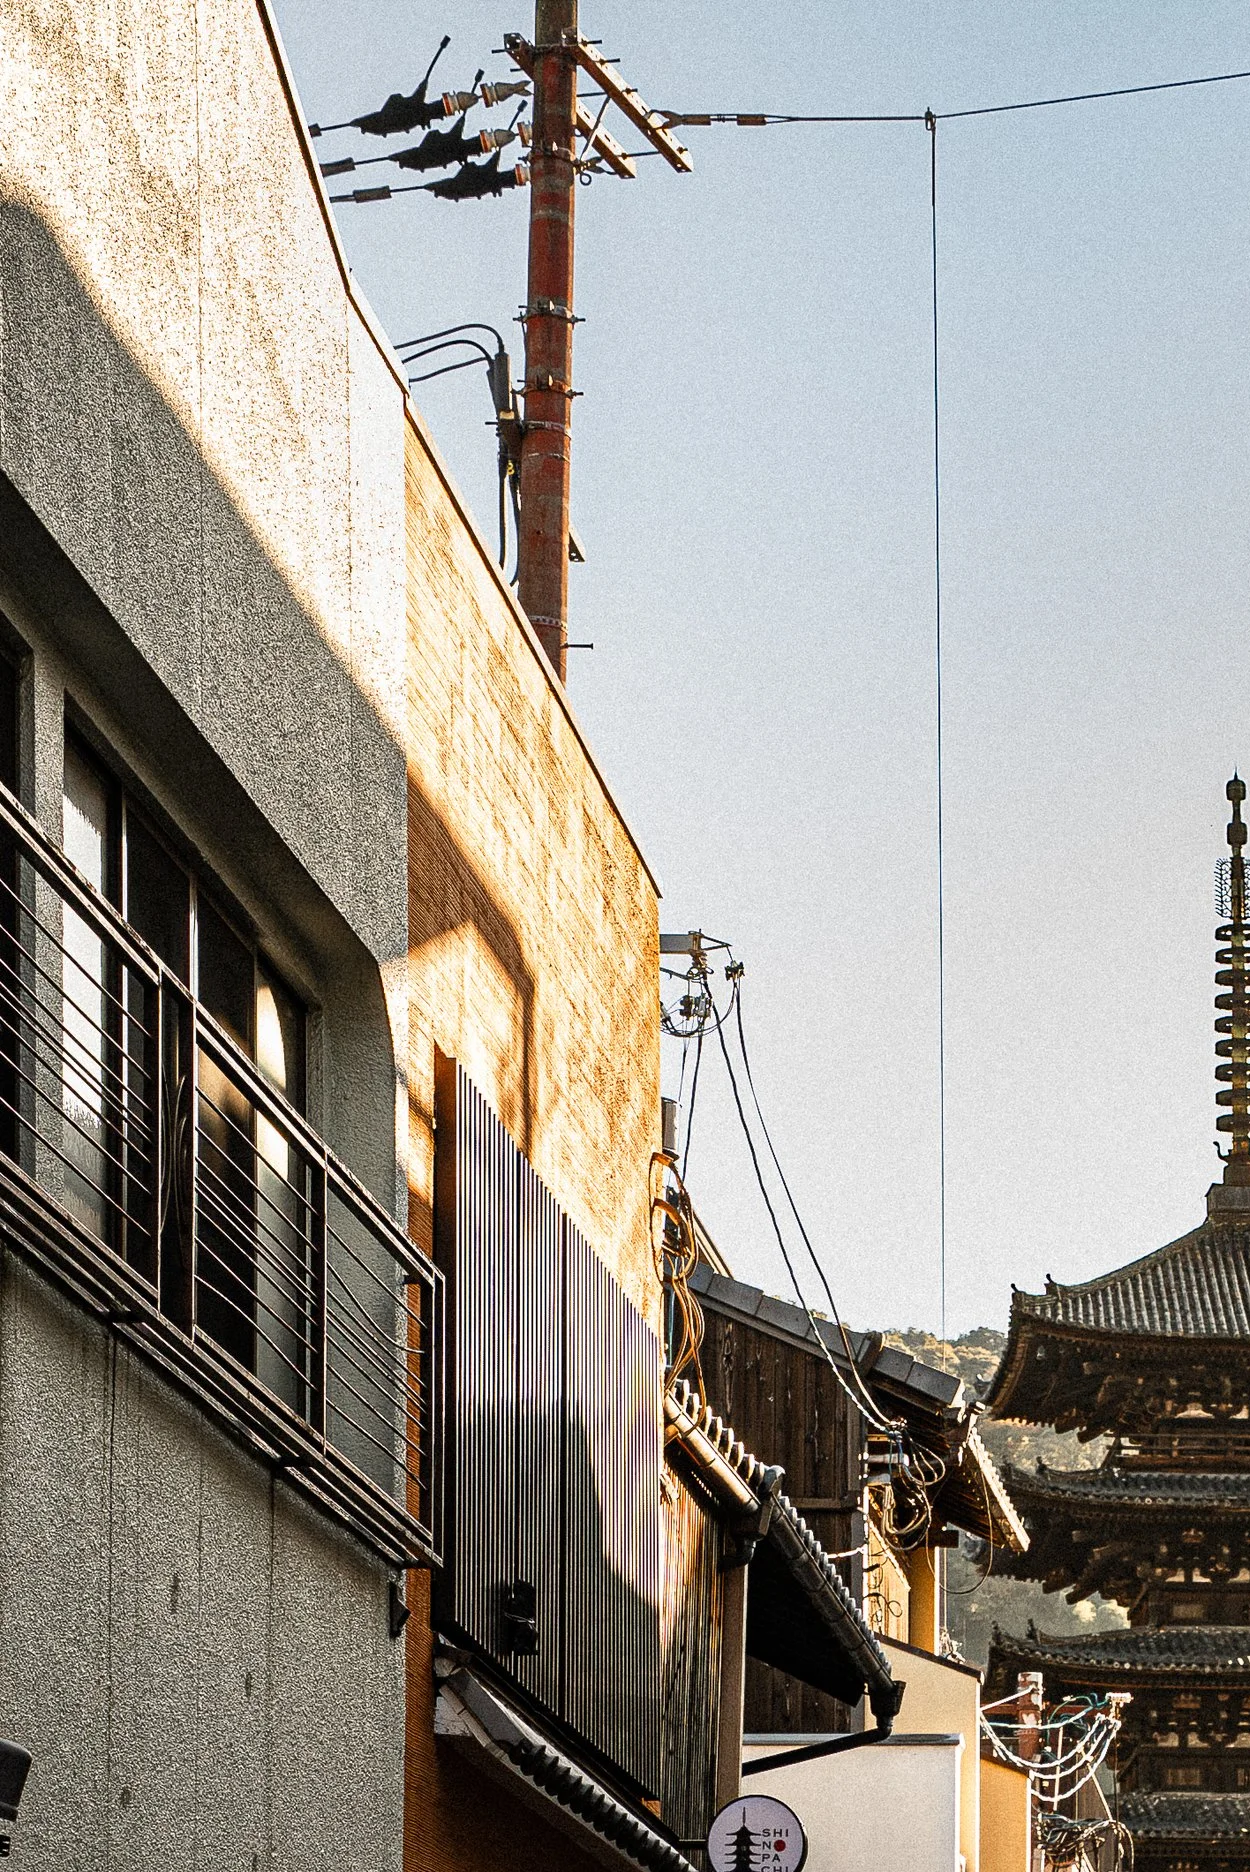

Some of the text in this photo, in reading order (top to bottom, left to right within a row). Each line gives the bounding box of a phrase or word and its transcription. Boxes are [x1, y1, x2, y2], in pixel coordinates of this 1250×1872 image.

[762, 1829, 789, 1838] SHI
[762, 1841, 771, 1850] N
[762, 1854, 781, 1862] PA
